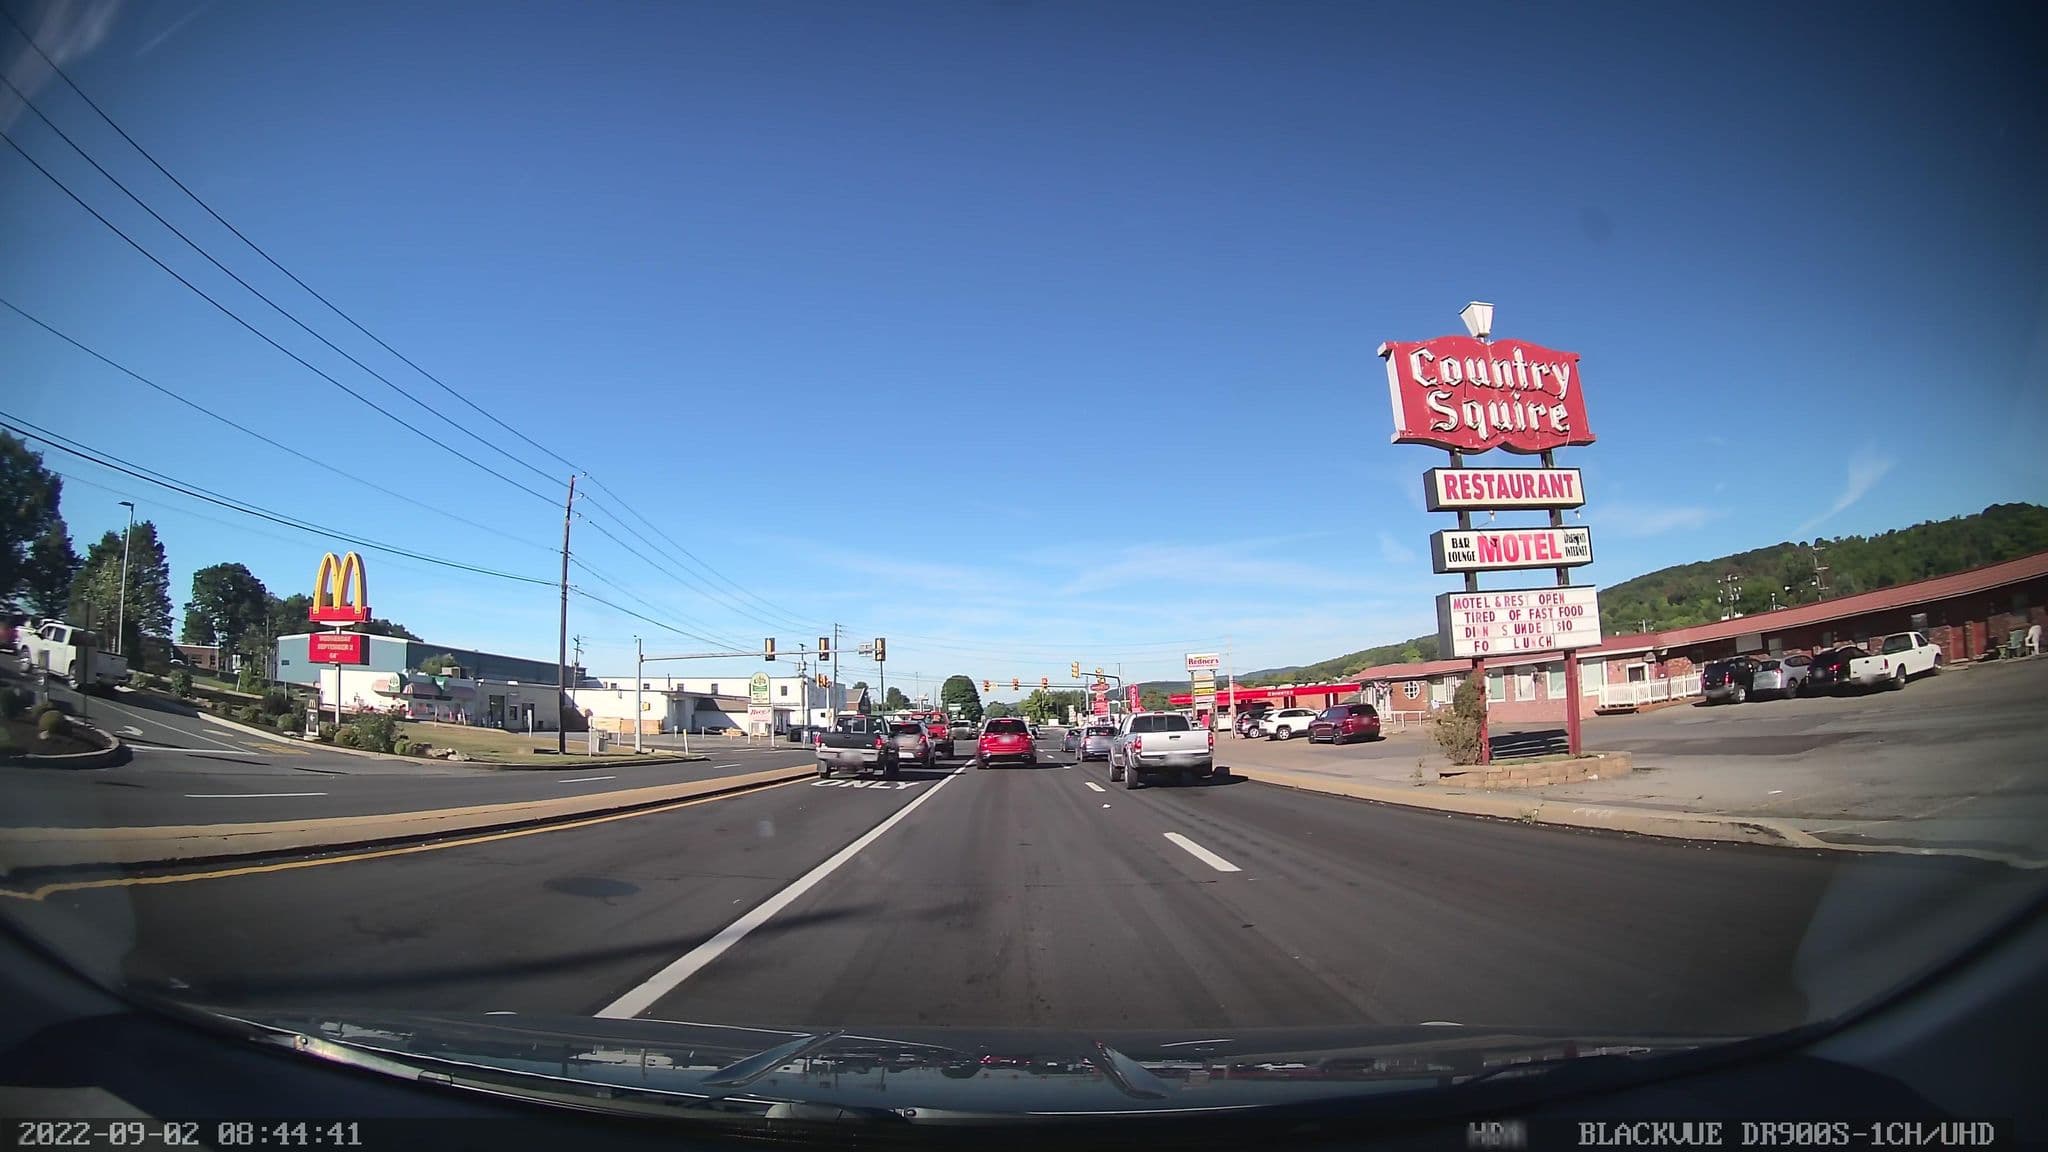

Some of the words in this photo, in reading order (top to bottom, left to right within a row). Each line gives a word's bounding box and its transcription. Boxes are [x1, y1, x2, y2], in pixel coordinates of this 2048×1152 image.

[1409, 346, 1570, 400] Country
[1426, 389, 1570, 441] Squire
[1443, 473, 1574, 500] RESTAURANT
[1451, 537, 1470, 549] BAR
[1477, 533, 1562, 563] MOTEL
[1448, 550, 1476, 563] LOUNGE
[1453, 597, 1491, 610] MOTEL
[1495, 595, 1501, 607] &
[1538, 593, 1565, 605] OPEN
[1464, 611, 1496, 624] TIRED
[1509, 609, 1521, 621] OF
[1529, 607, 1553, 620] FAST
[1559, 605, 1584, 617] FOOD
[1557, 620, 1573, 632] $10
[811, 779, 919, 790] ONLY
